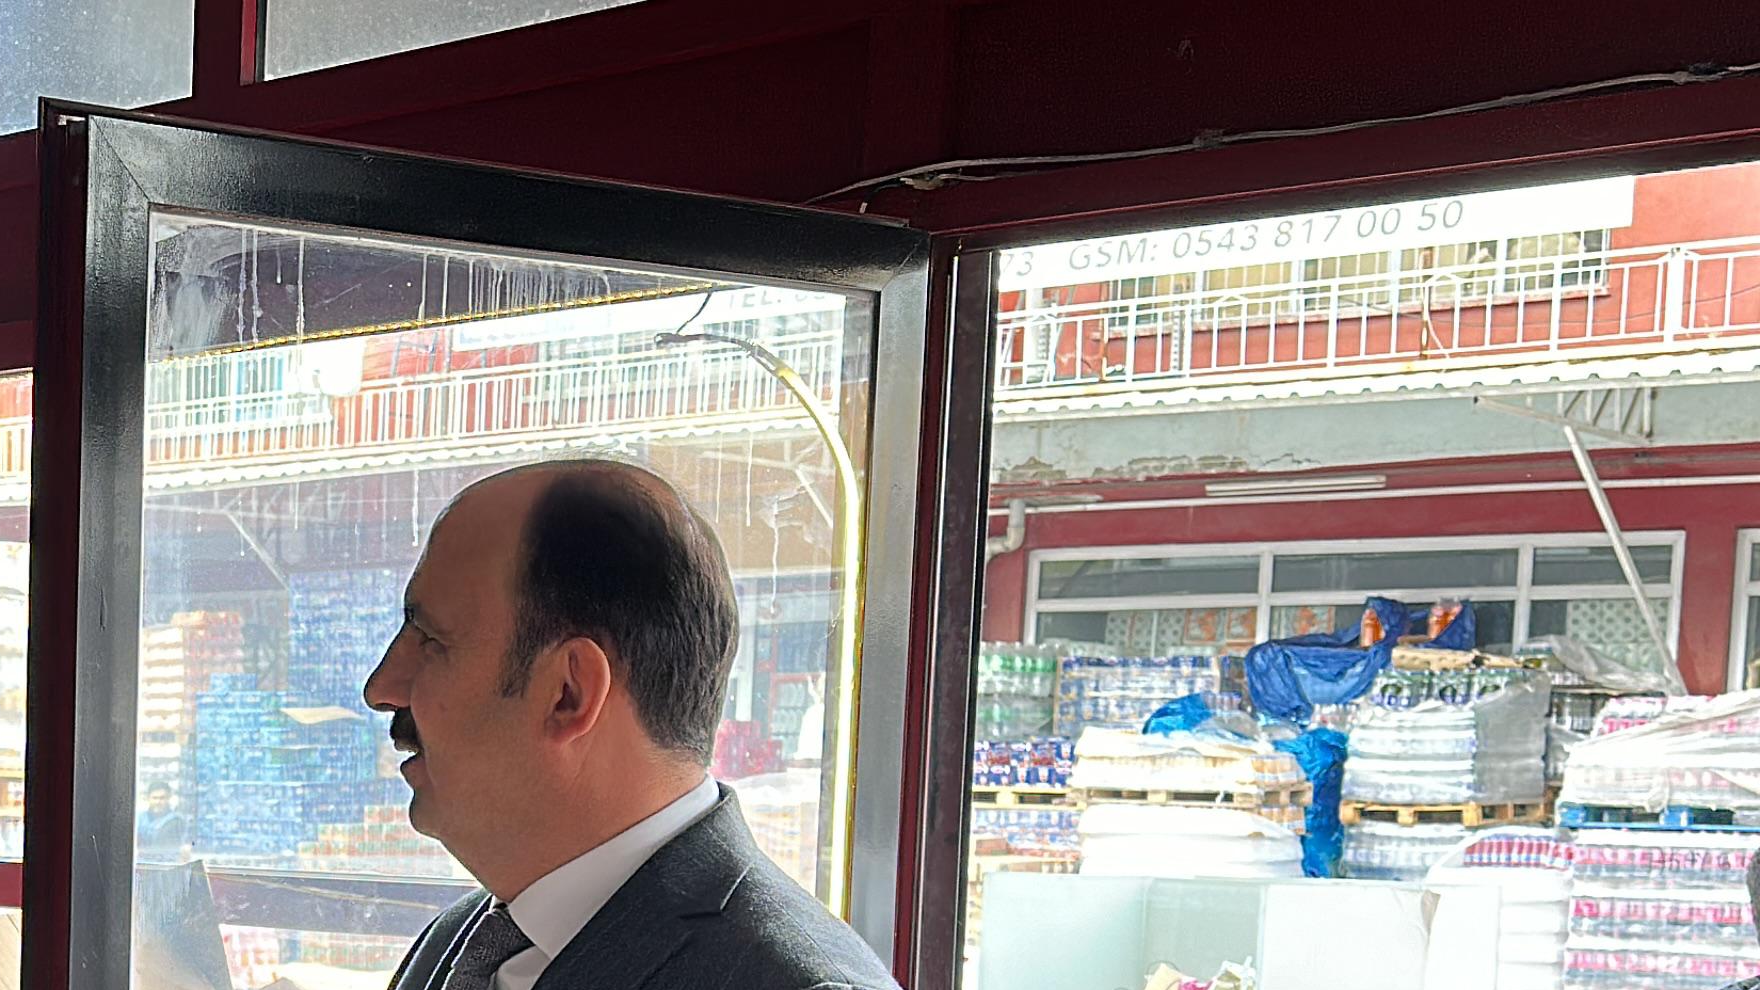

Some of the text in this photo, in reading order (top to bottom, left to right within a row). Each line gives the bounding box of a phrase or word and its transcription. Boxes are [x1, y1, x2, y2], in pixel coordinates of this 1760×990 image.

[1069, 240, 1157, 270] GSM:
[1172, 225, 1258, 259] 0543
[1273, 215, 1340, 248] 817
[1356, 208, 1400, 239] 00
[1417, 199, 1463, 232] 50
